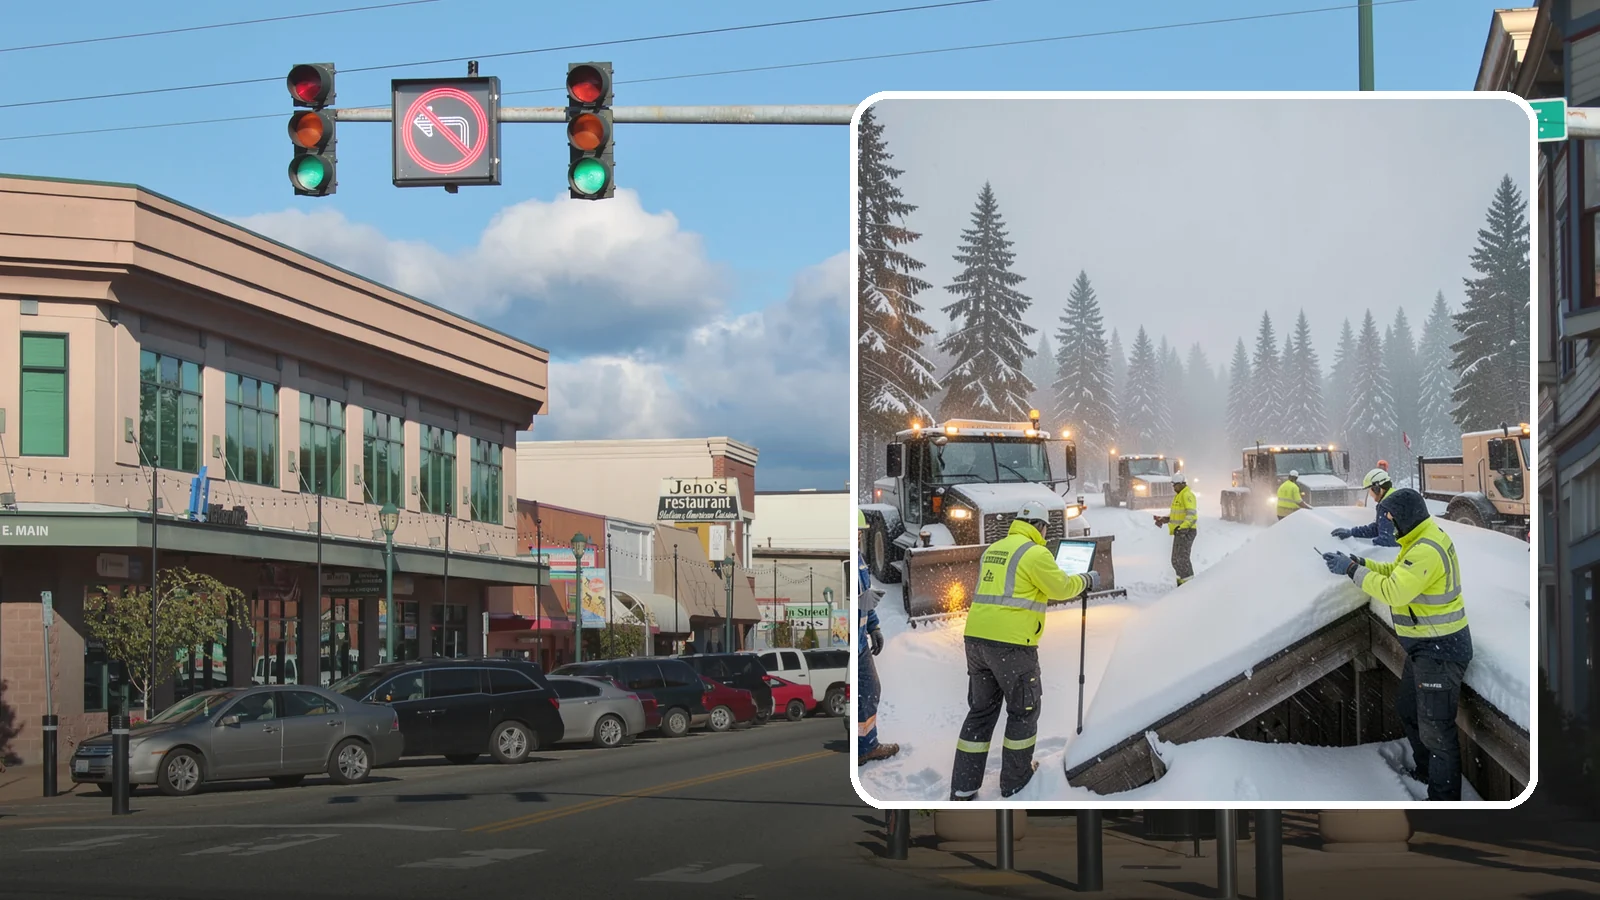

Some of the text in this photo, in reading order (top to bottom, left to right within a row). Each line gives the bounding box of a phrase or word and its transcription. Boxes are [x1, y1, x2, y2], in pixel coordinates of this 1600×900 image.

[669, 480, 727, 494] Jeno's
[665, 496, 731, 509] restaurant
[715, 509, 737, 519] Cuisine
[2, 525, 49, 536] E. MAIN
[797, 607, 828, 617] Street
